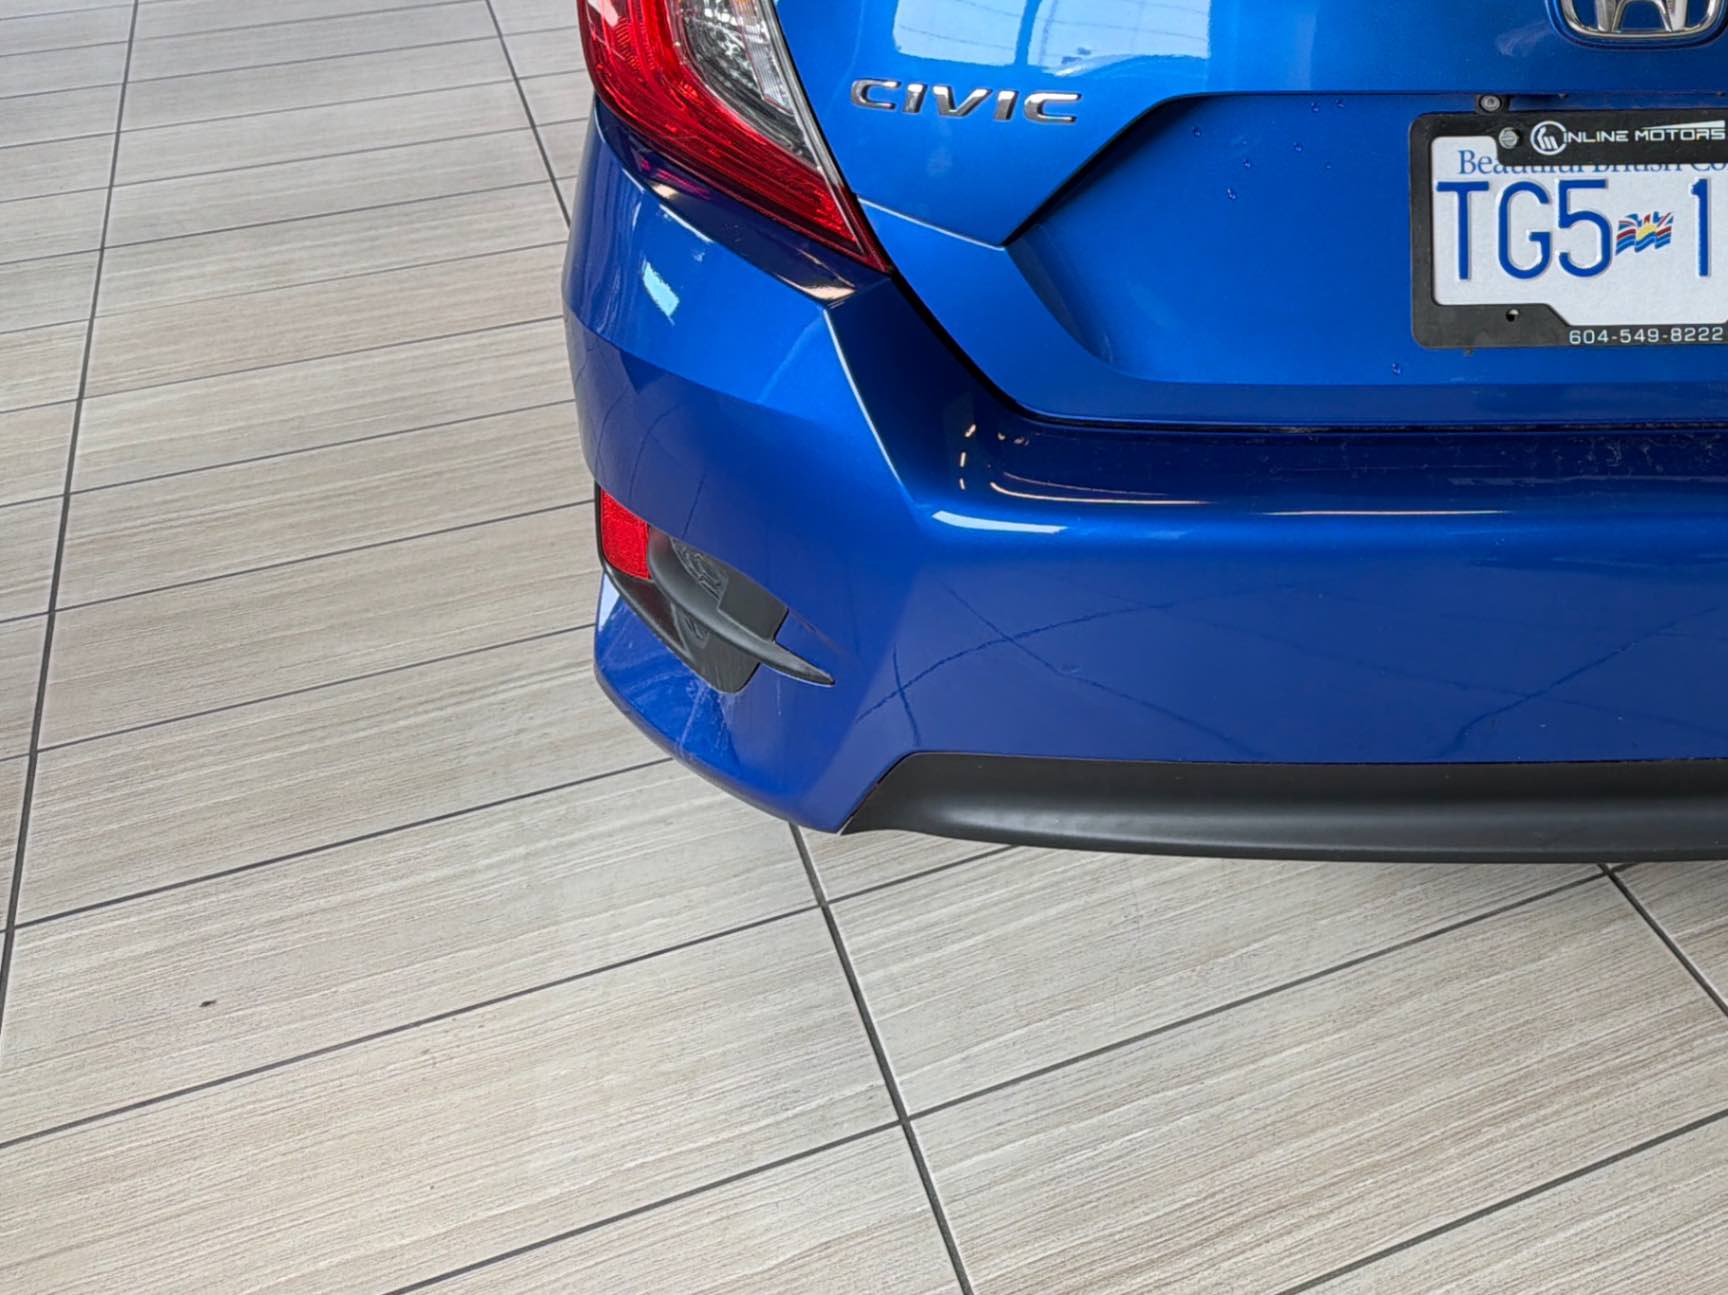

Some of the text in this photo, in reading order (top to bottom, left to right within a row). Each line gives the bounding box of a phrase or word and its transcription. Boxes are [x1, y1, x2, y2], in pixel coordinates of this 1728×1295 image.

[851, 78, 1083, 124] CIVIC
[1436, 177, 1614, 281] TG5
[1568, 326, 1725, 345] 604-549-8222
